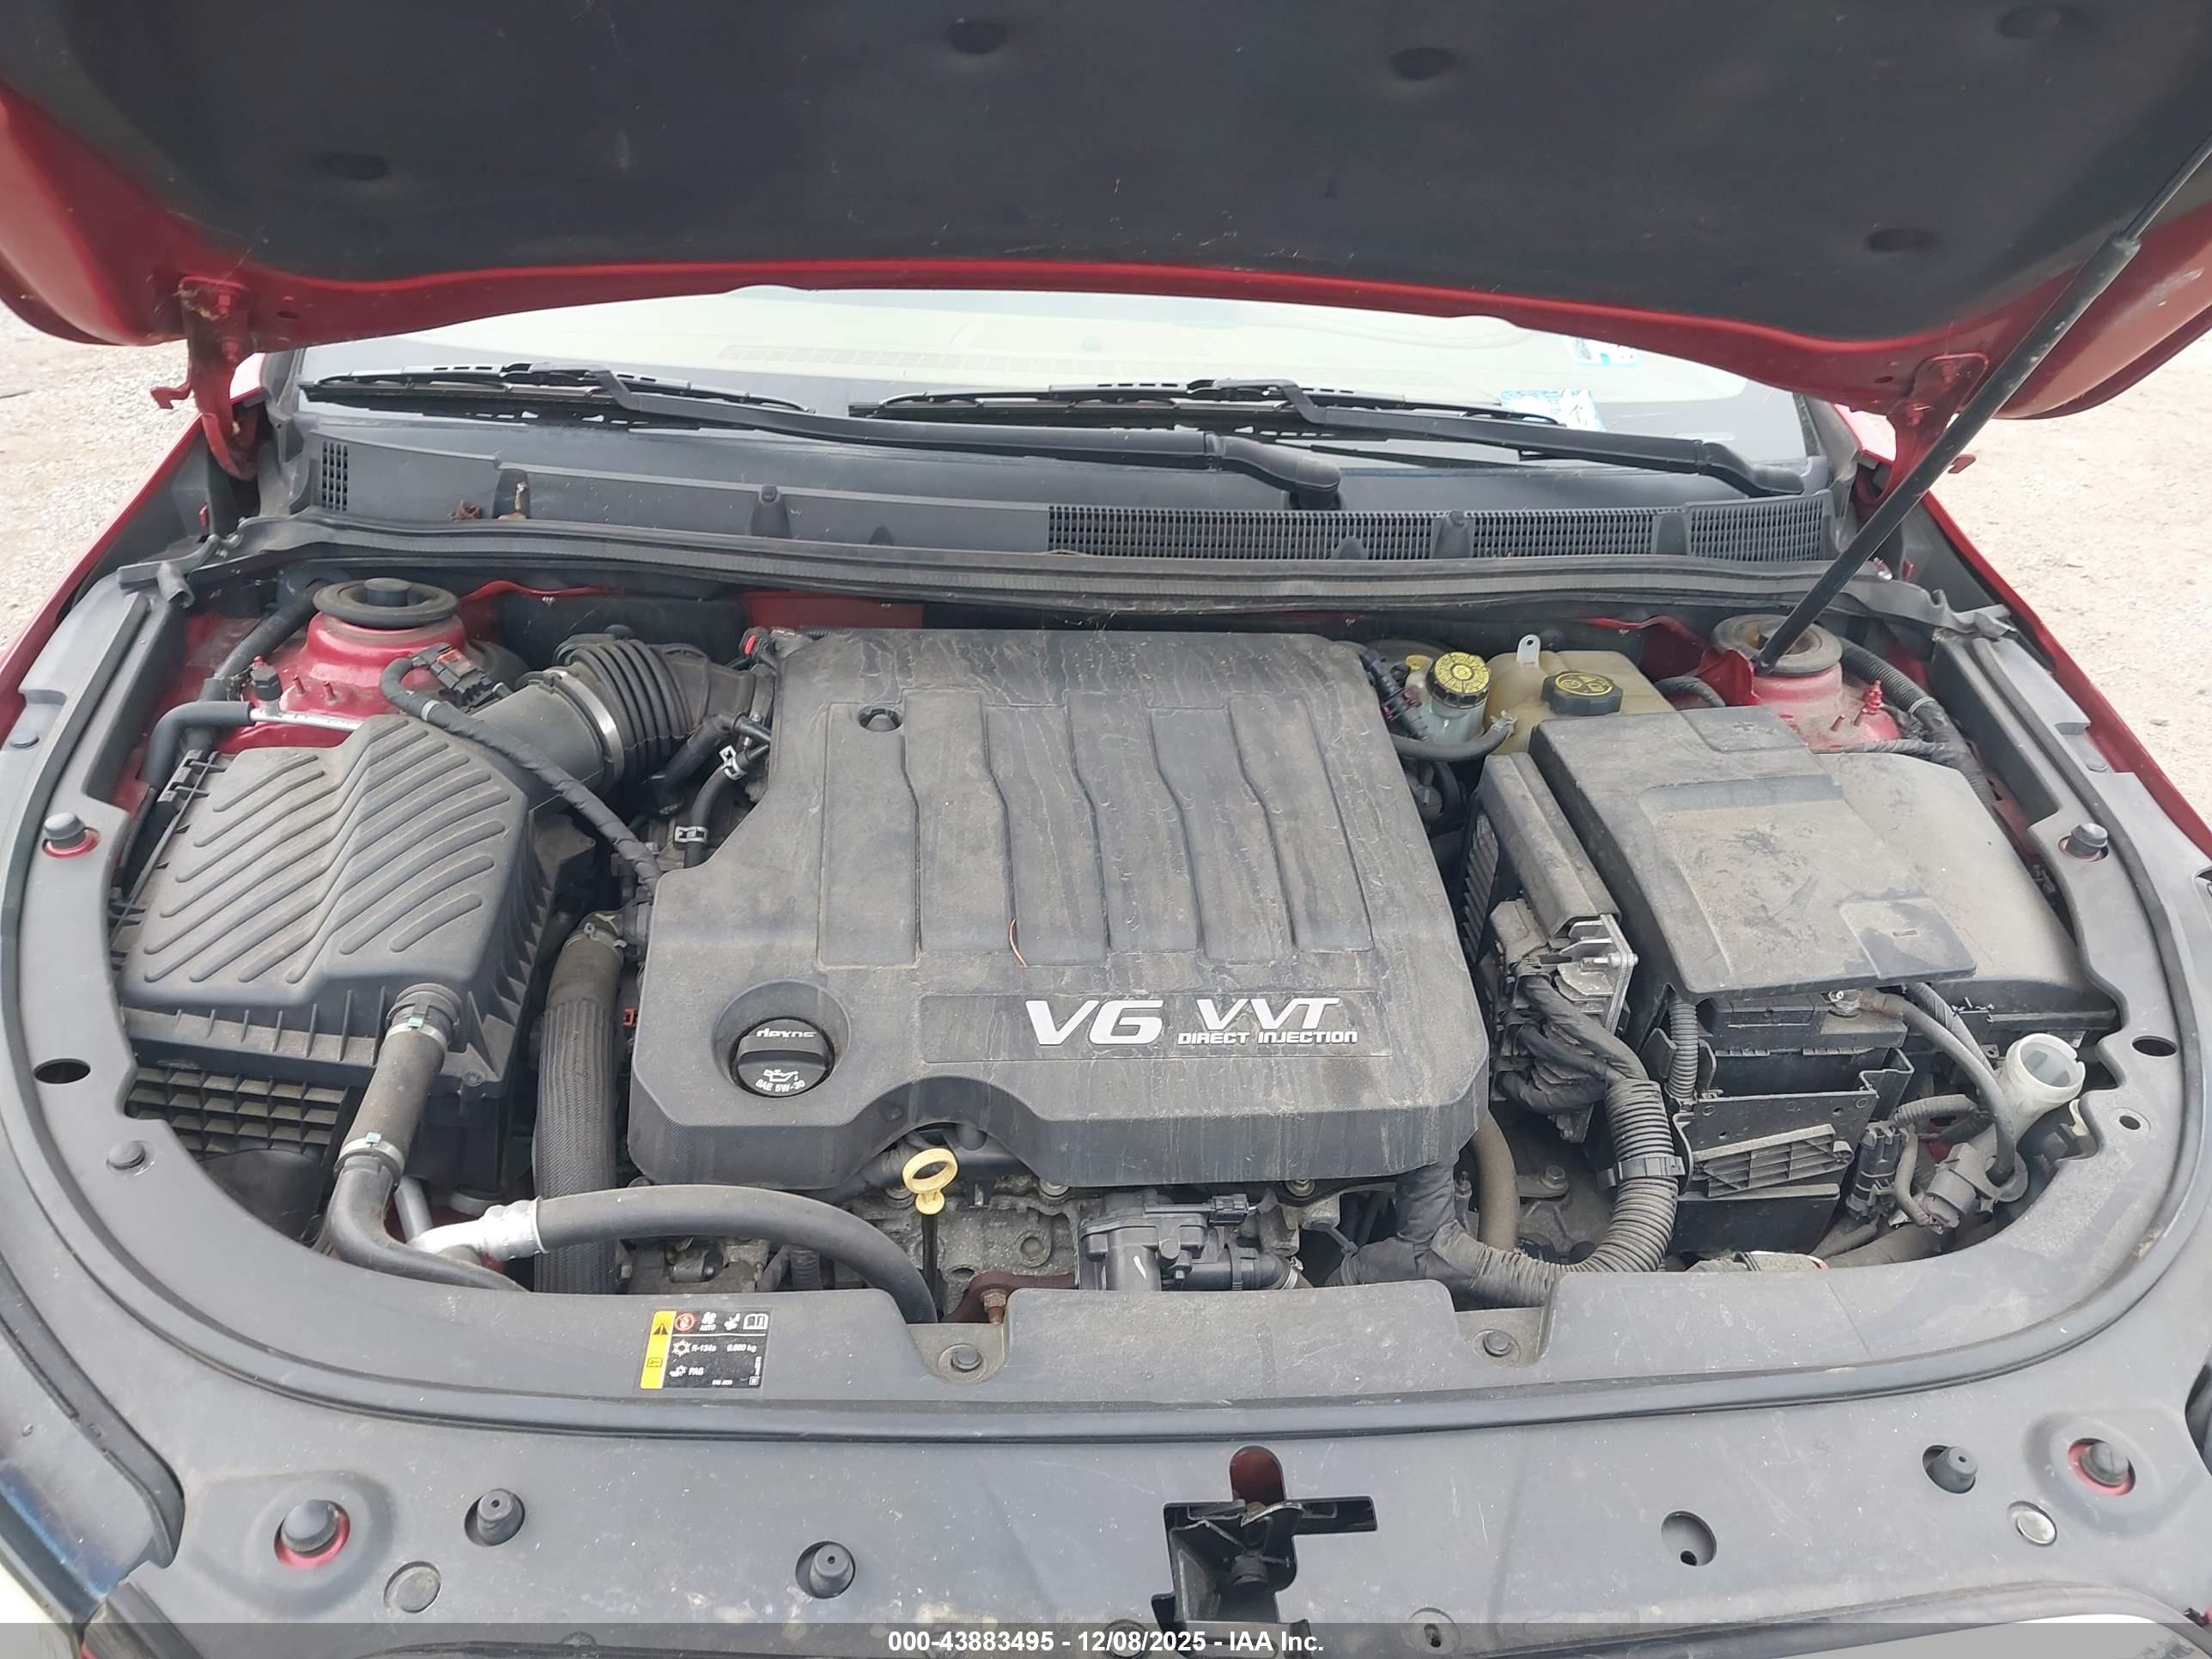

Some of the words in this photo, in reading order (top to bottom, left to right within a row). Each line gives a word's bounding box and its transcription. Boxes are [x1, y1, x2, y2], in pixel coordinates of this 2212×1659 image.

[1024, 999, 1164, 1046] V6
[1196, 997, 1340, 1030] VVT
[1176, 1030, 1251, 1046] DIRECT
[1257, 1030, 1358, 1045] INJECTION
[755, 1079, 774, 1091] SAE
[775, 1079, 805, 1092] 5W-30
[747, 1344, 757, 1353] kg
